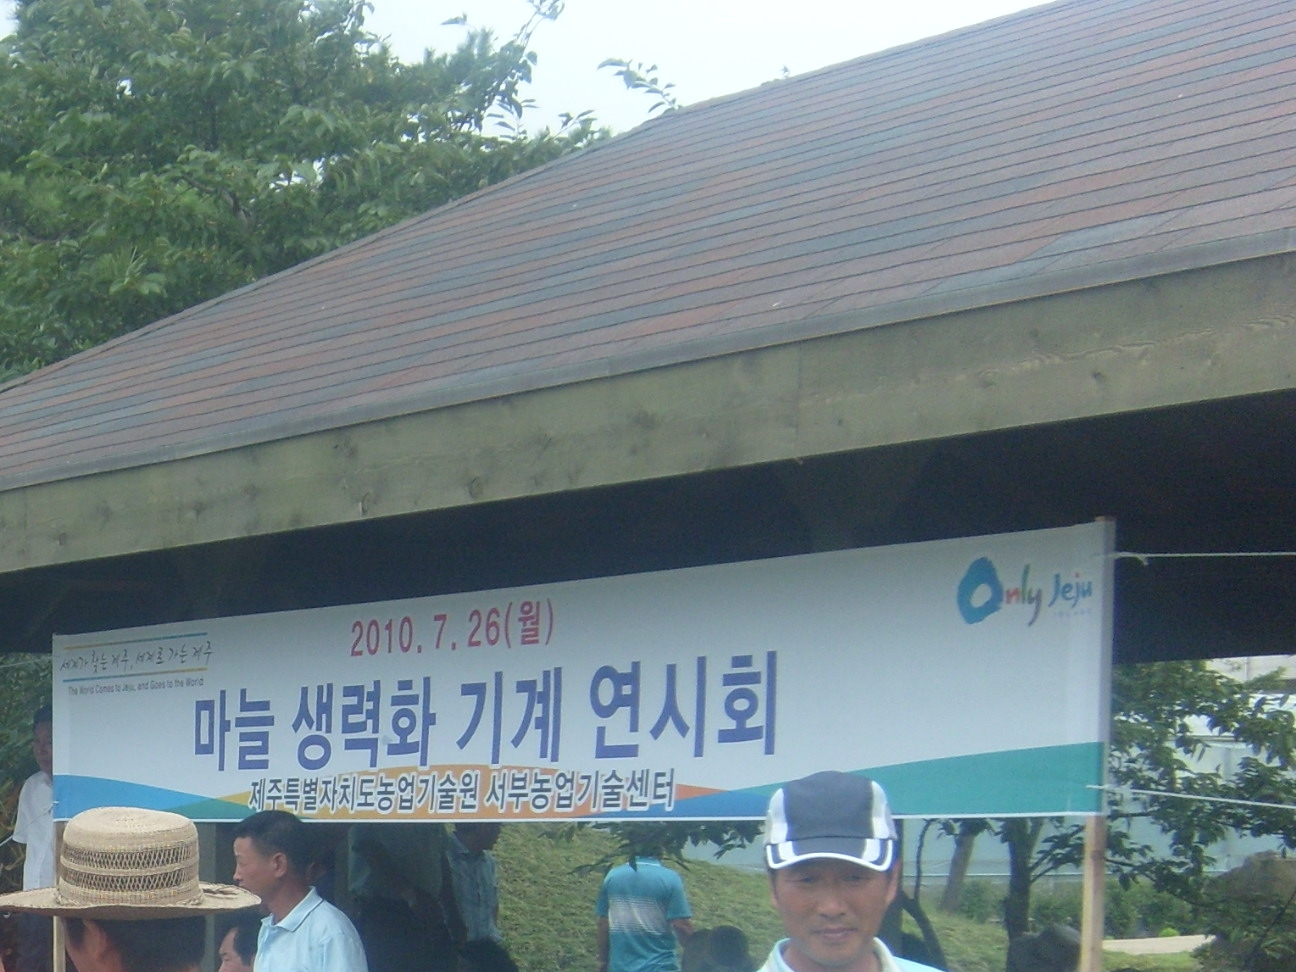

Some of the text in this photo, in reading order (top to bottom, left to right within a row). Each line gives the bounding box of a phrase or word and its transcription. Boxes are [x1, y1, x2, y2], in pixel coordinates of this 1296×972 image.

[957, 557, 1094, 627] Only Jeju
[350, 598, 555, 658] 2010. 7. 26(월)
[194, 651, 777, 771] 마늘 생력화 기계 연시회
[249, 768, 675, 813] 제주특별자치도농업기술원 서부농업기술센터
